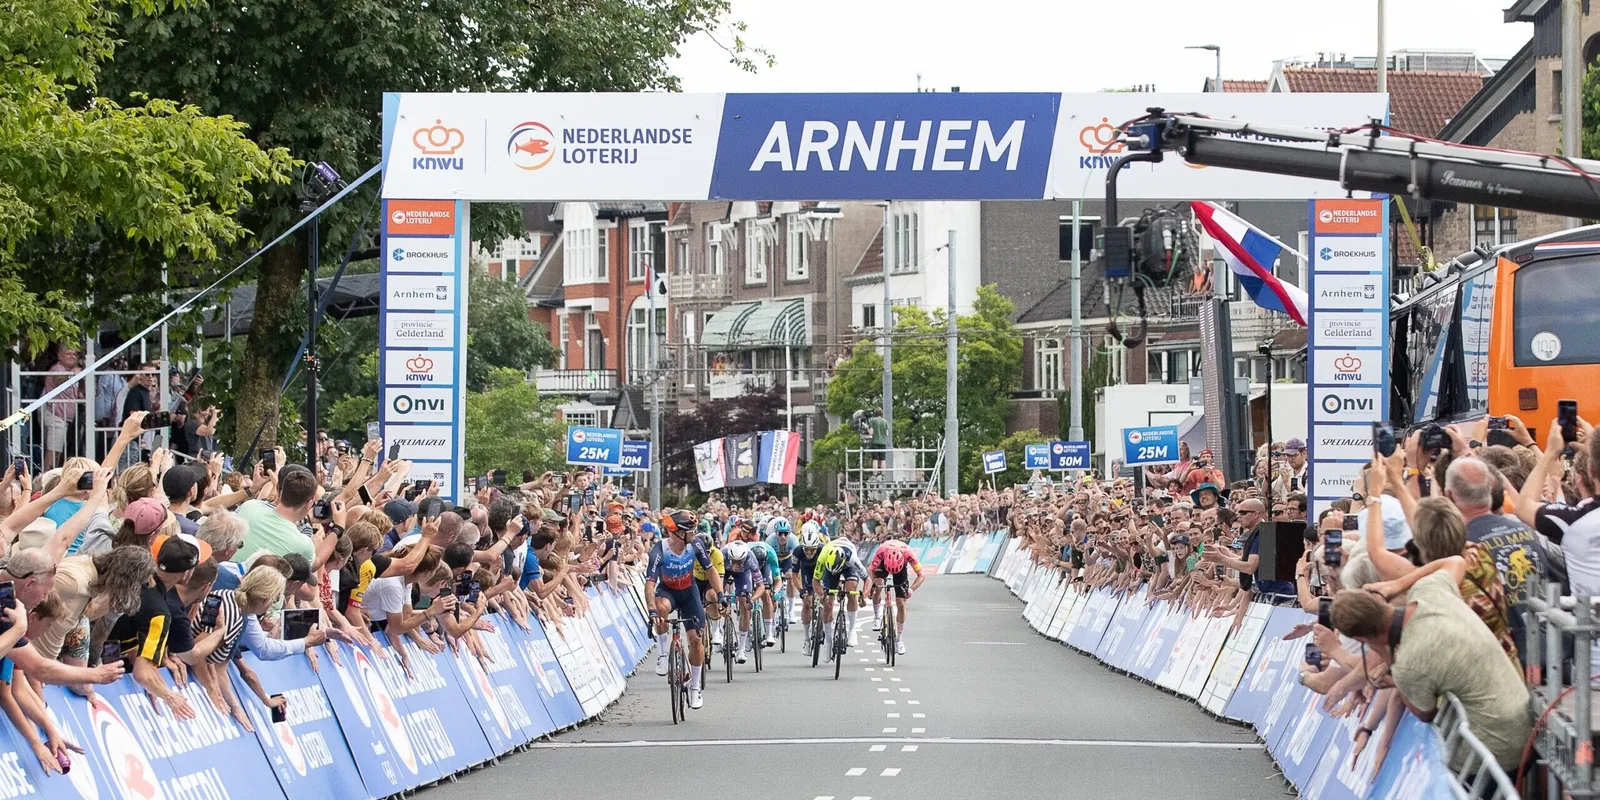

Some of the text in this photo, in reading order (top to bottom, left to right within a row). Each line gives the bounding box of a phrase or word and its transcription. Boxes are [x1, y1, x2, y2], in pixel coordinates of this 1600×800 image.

[562, 128, 692, 144] NEDERLANDSE
[749, 120, 1025, 171] ARNHEM
[562, 149, 638, 164] LOTERIJ
[1329, 320, 1361, 328] provincie
[396, 329, 444, 338] Gelderland
[1324, 329, 1372, 337] Gelderland
[393, 438, 446, 446] SPECIALIZED
[579, 447, 610, 460] 25M
[1137, 446, 1168, 460] 25M
[1059, 456, 1082, 466] 50M
[1320, 478, 1354, 486] Arnhe
[1504, 531, 1534, 546] MAN
[401, 707, 456, 766] LOTERIJ
